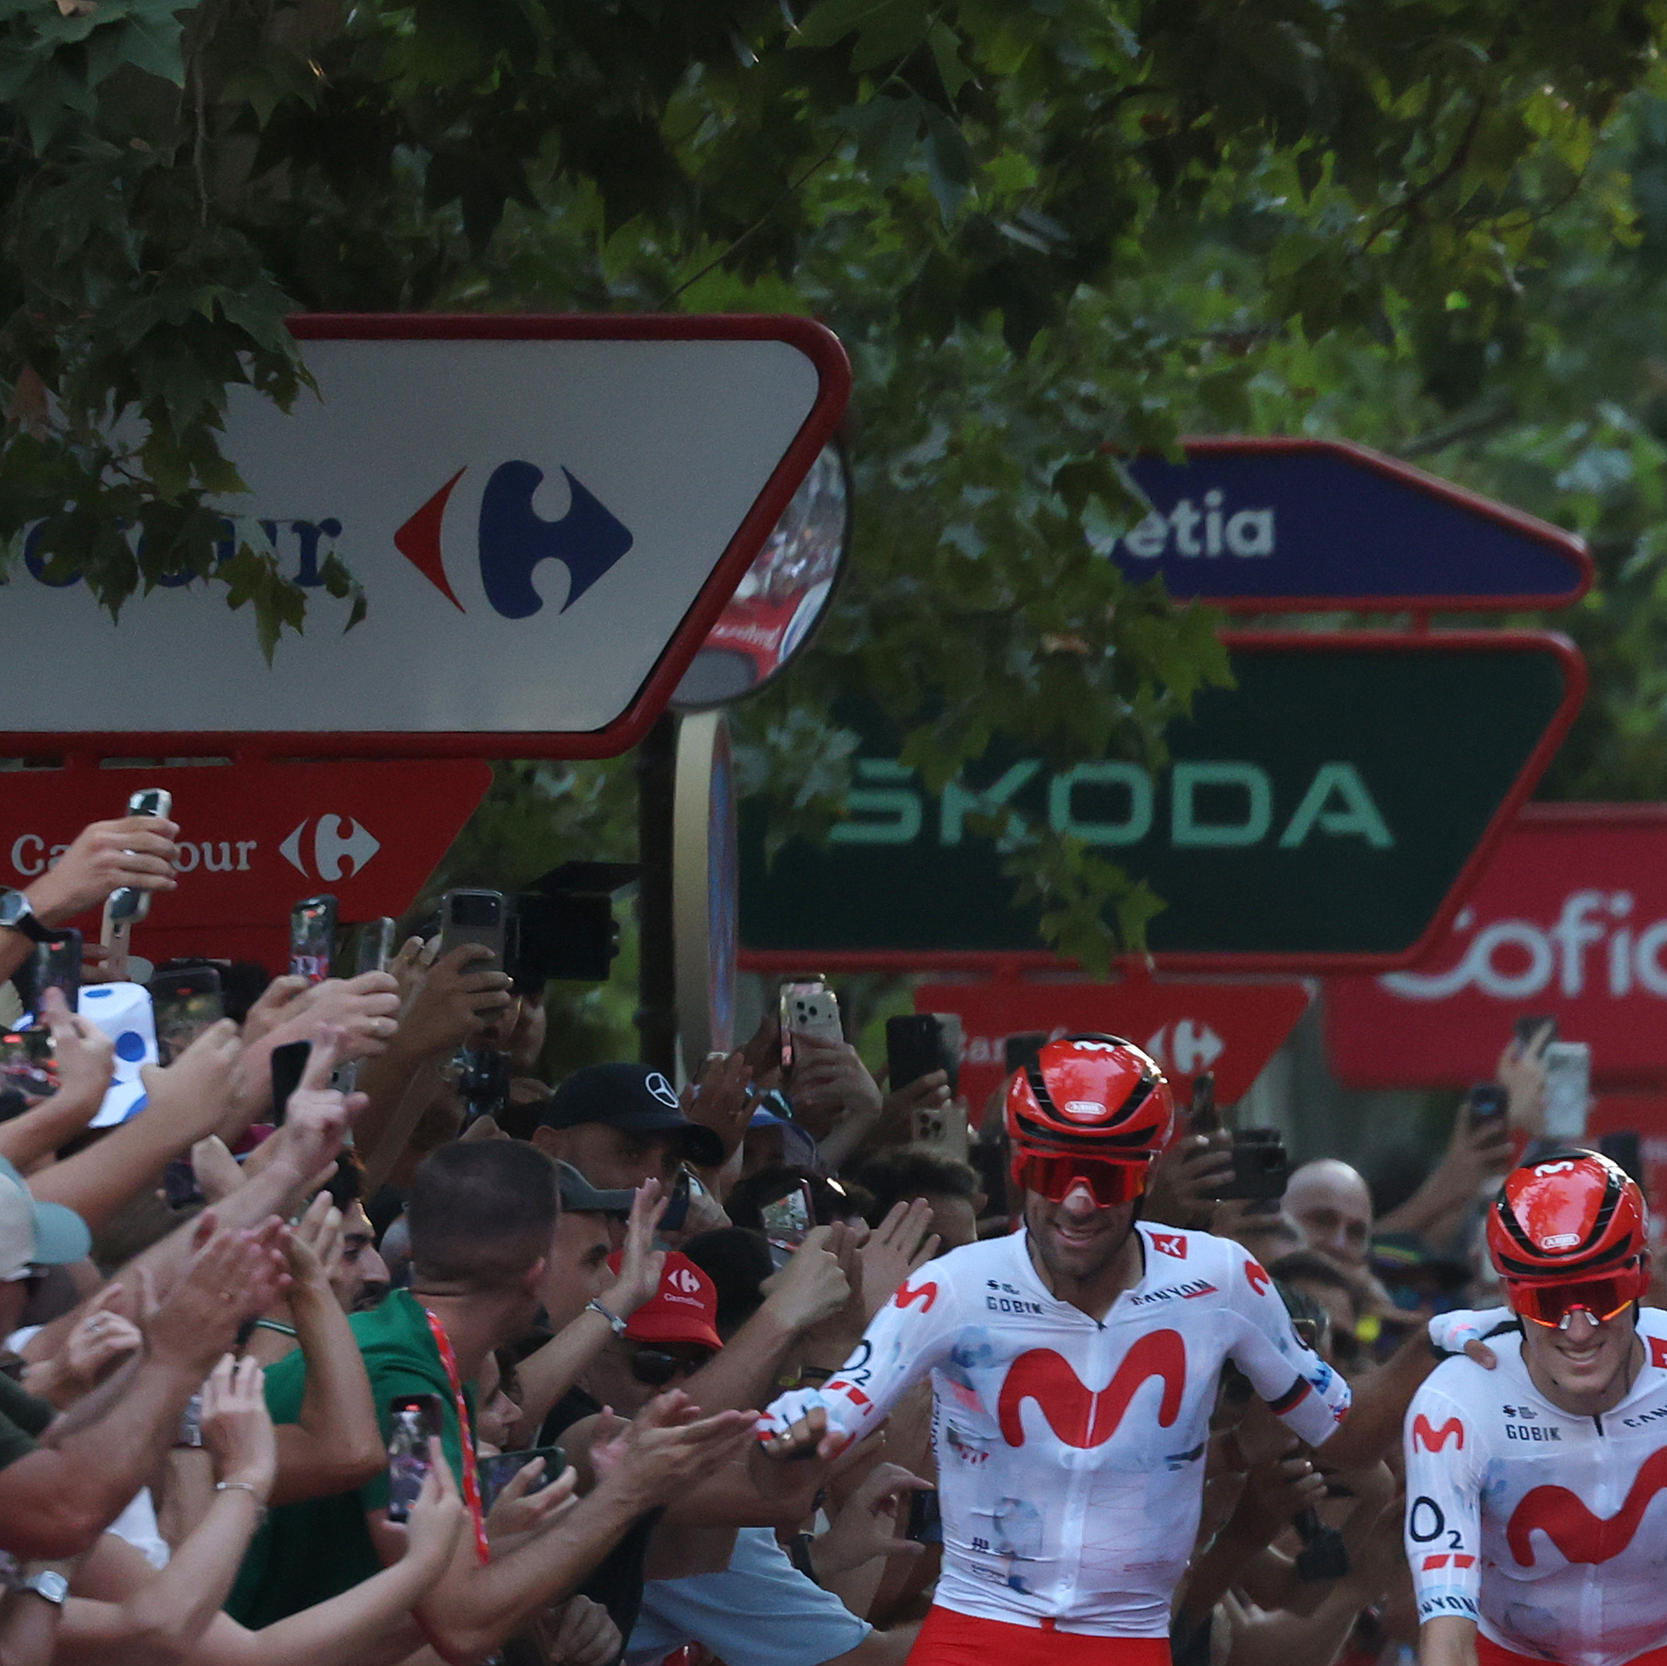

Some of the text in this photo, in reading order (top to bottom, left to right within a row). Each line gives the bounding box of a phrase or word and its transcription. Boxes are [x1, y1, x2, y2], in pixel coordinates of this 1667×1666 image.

[12, 833, 258, 879] Caour
[986, 1296, 1044, 1315] GOBIK
[1505, 1423, 1562, 1442] GOBIK
